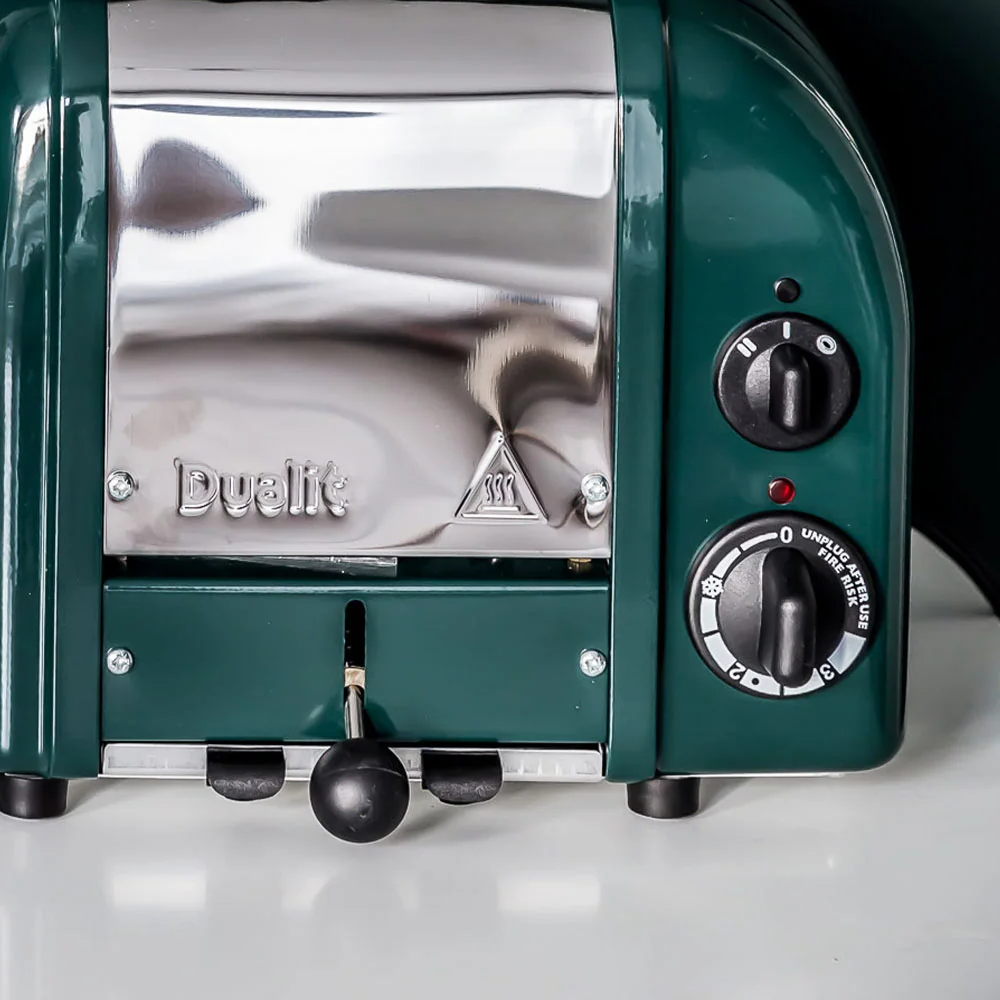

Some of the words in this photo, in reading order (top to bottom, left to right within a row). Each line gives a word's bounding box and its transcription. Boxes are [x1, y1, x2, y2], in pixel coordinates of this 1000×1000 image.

[174, 457, 349, 518] Dualit
[801, 527, 851, 564] UNPLUG
[845, 563, 869, 603] AFTER
[857, 604, 870, 631] USE
[817, 546, 846, 574] FIRE
[840, 574, 859, 608] RISK
[728, 661, 747, 681] 2
[819, 663, 836, 681] 3
